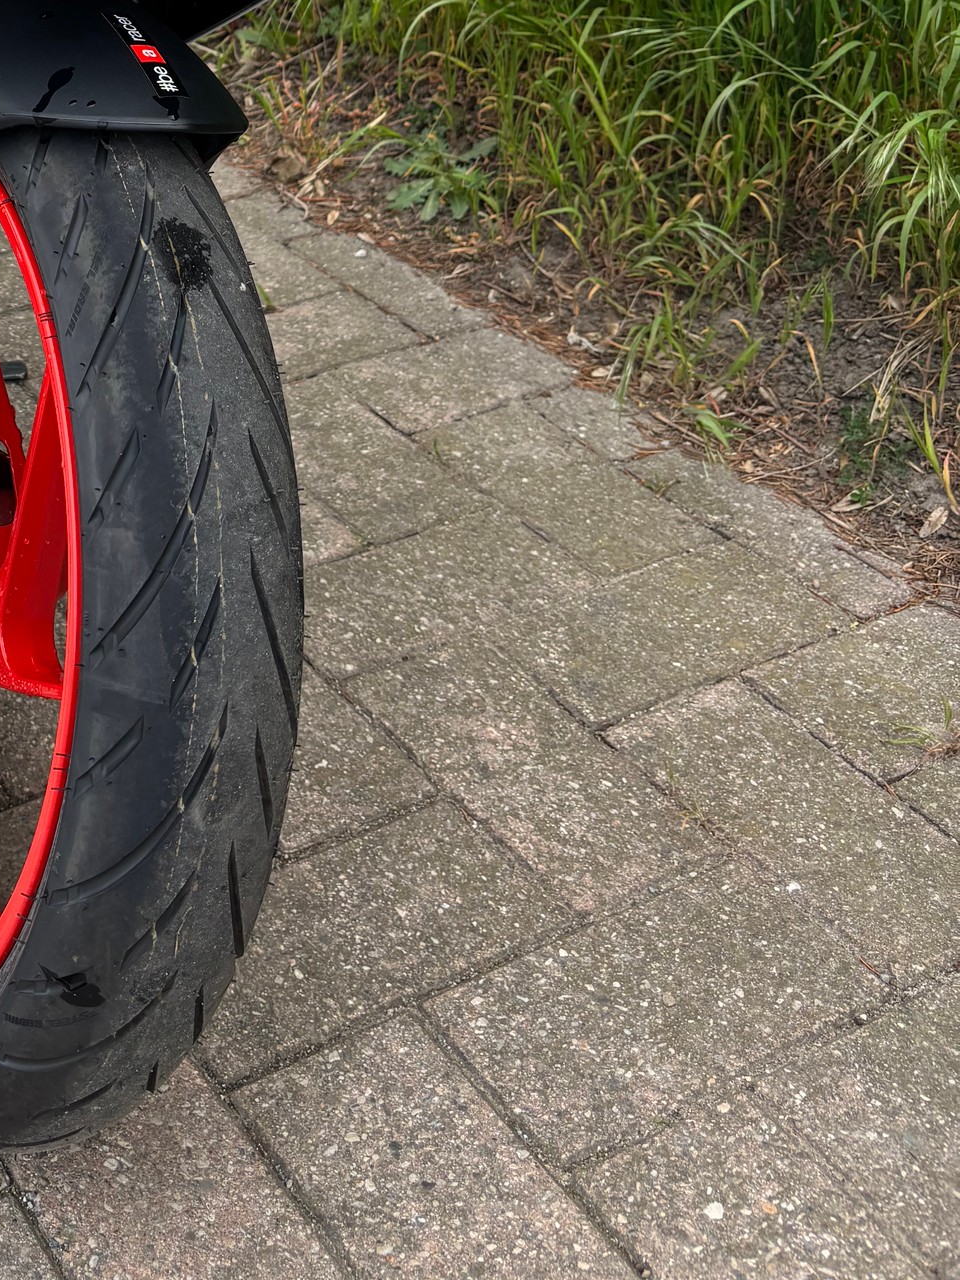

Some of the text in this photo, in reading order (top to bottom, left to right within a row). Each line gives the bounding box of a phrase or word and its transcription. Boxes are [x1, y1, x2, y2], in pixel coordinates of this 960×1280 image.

[113, 14, 179, 92] #be a racer
